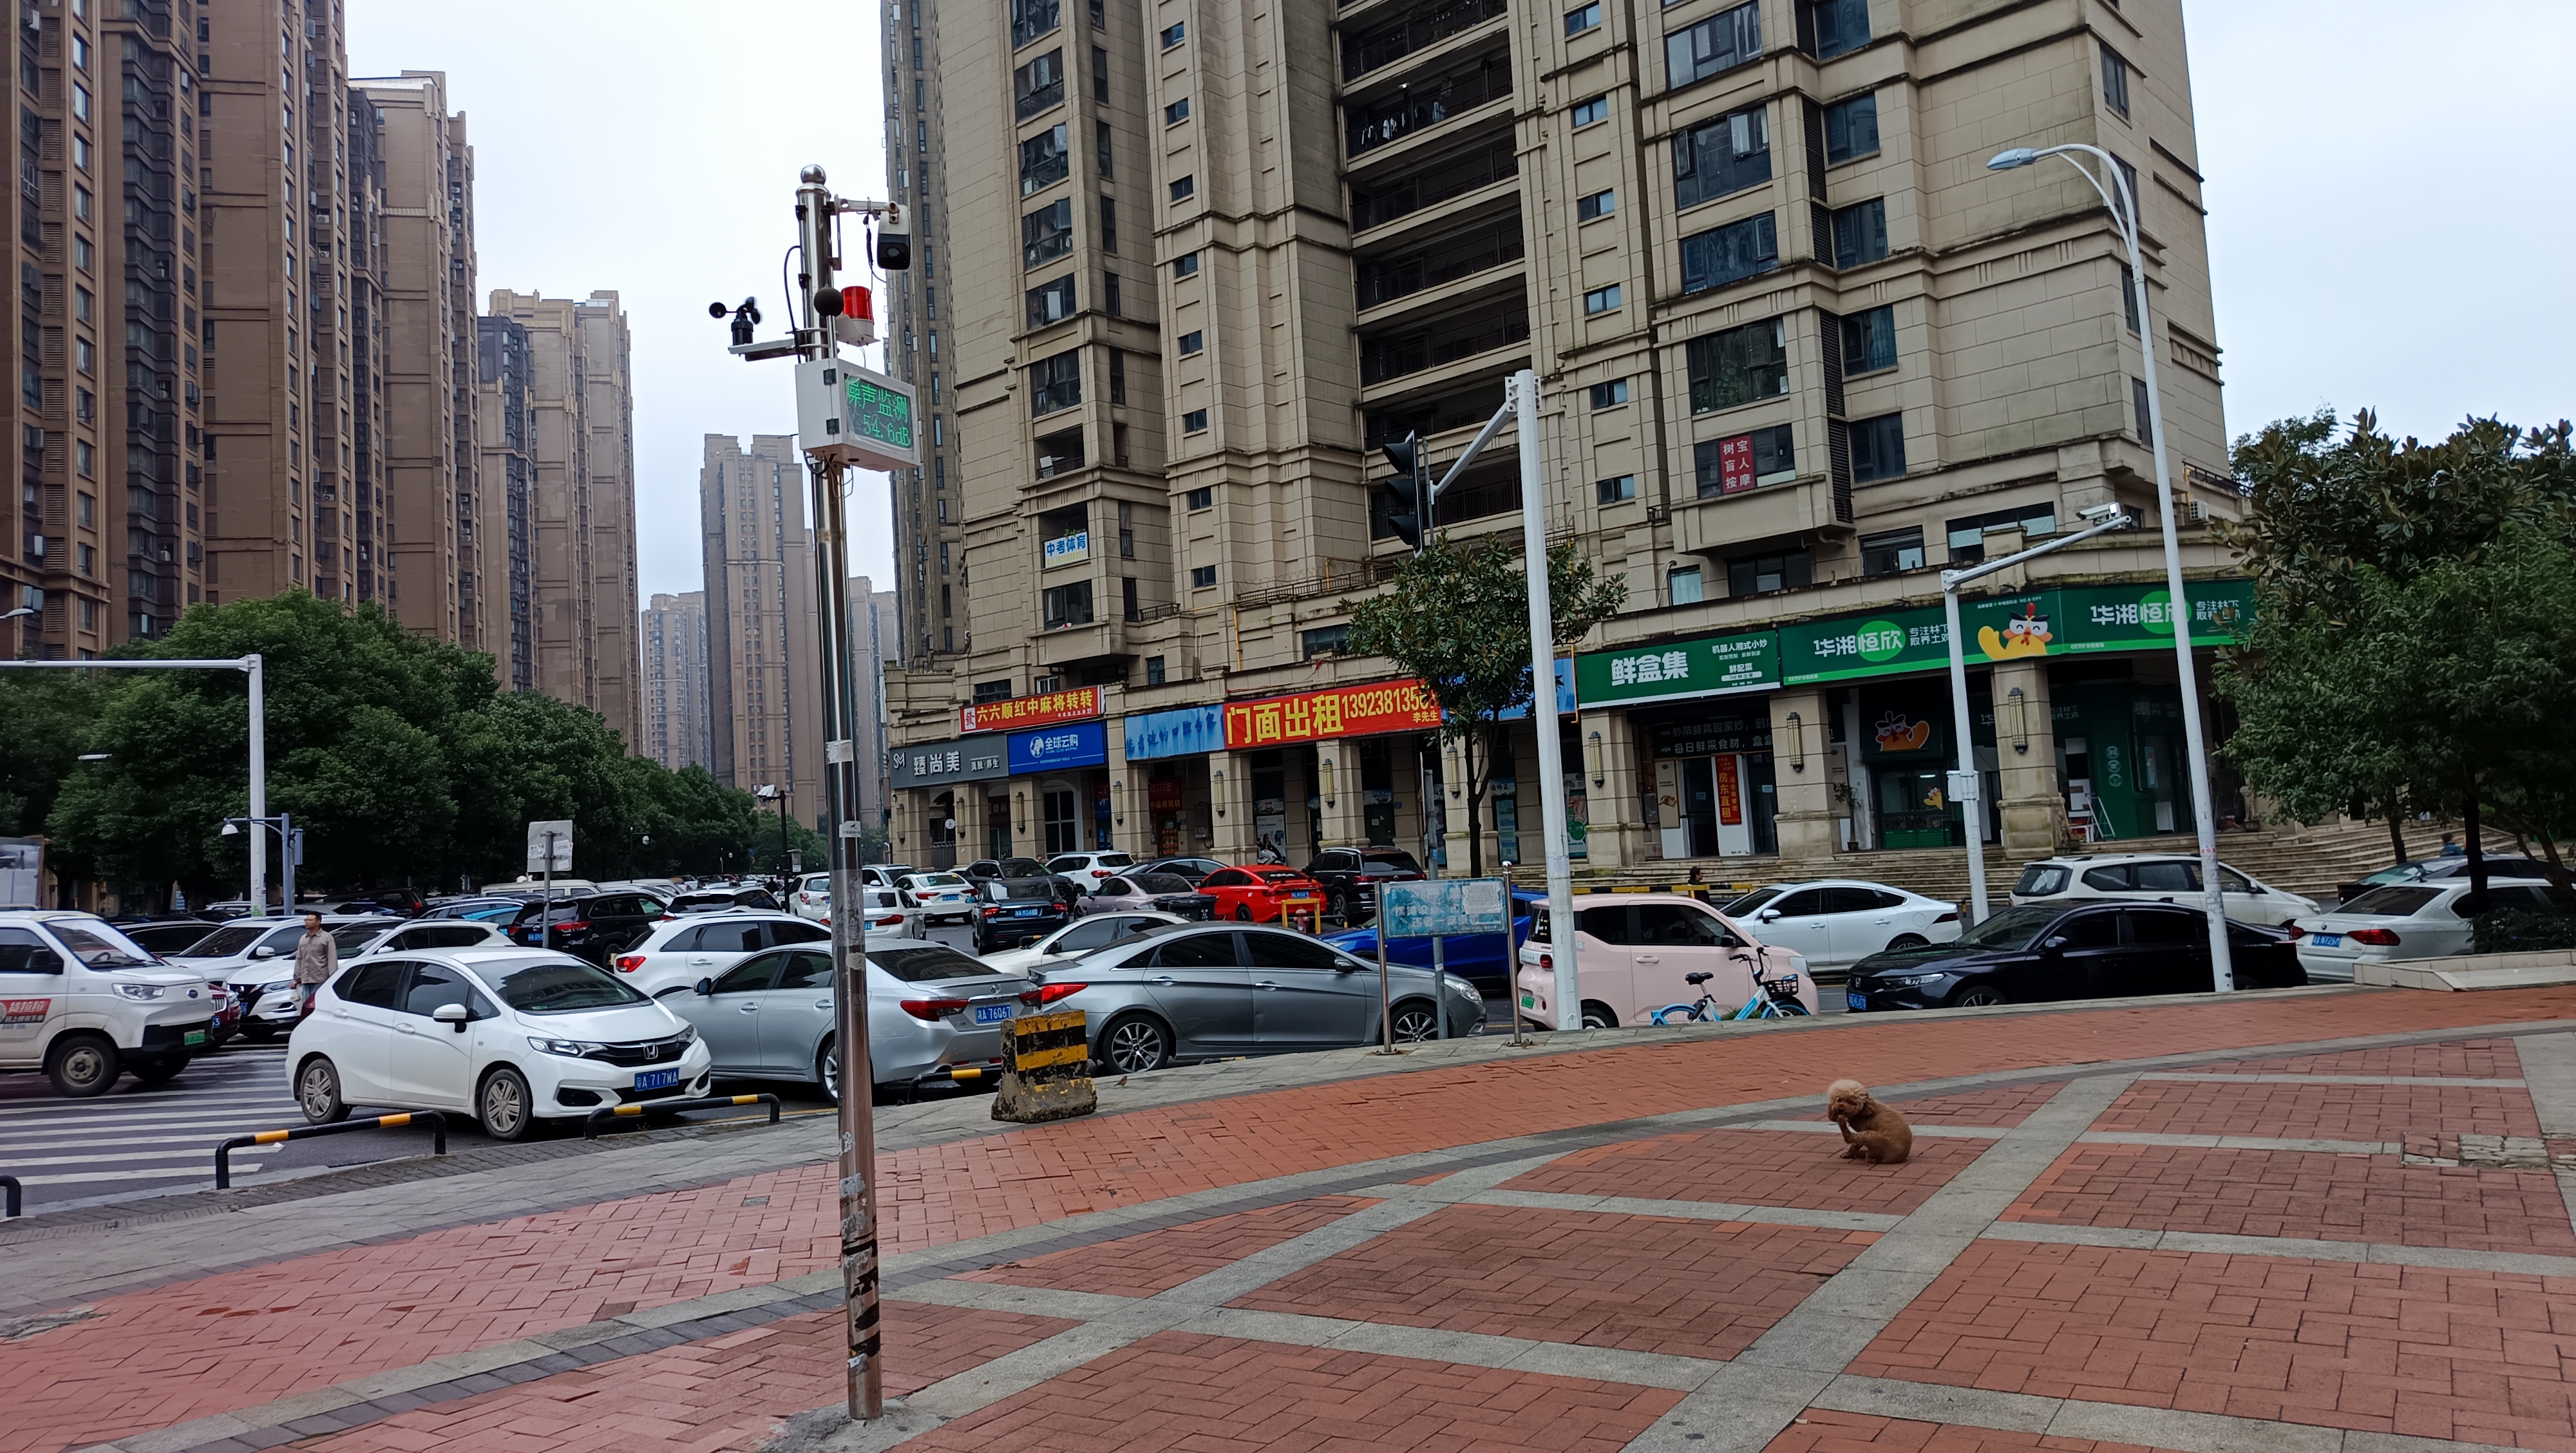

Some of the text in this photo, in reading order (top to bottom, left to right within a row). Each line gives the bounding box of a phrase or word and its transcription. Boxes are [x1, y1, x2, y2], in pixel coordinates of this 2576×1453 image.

[864, 414, 911, 446] 54.6dB
[1046, 535, 1086, 556] 中考体育
[1712, 639, 1767, 654] 机器人湘式小炒
[1814, 629, 1903, 658] 华湘恒欣
[1611, 651, 1689, 686] 鲜盒集
[1729, 663, 1753, 673] 鲜配菜
[977, 689, 1093, 723] 六六顺红中麻将转转
[1227, 694, 1343, 745] 门面出租
[1413, 710, 1439, 723] 李先生
[1045, 734, 1079, 750] 全球云购
[914, 750, 960, 775] 臻尚美
[1719, 772, 1732, 817] 房东直租
